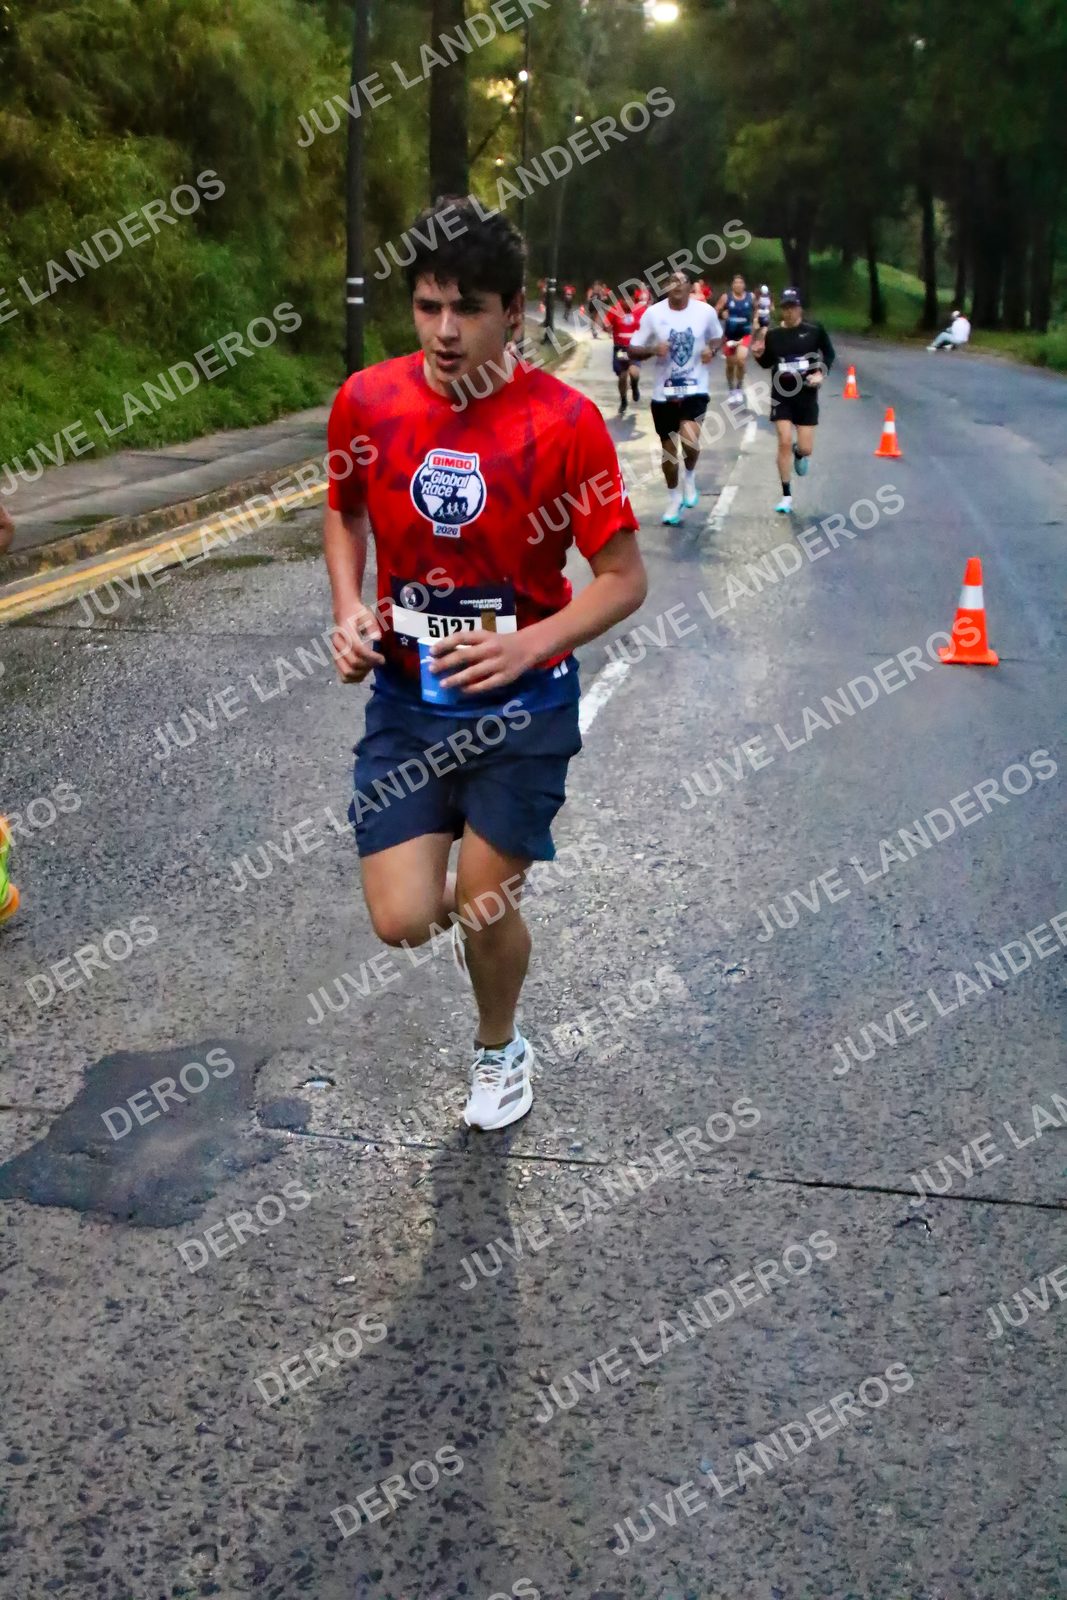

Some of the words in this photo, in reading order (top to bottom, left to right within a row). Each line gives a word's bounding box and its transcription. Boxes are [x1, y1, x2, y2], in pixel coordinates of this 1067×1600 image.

[432, 456, 472, 470] BIMBO
[431, 471, 470, 488] Global
[421, 481, 453, 497] Race
[427, 616, 475, 638] 5127
